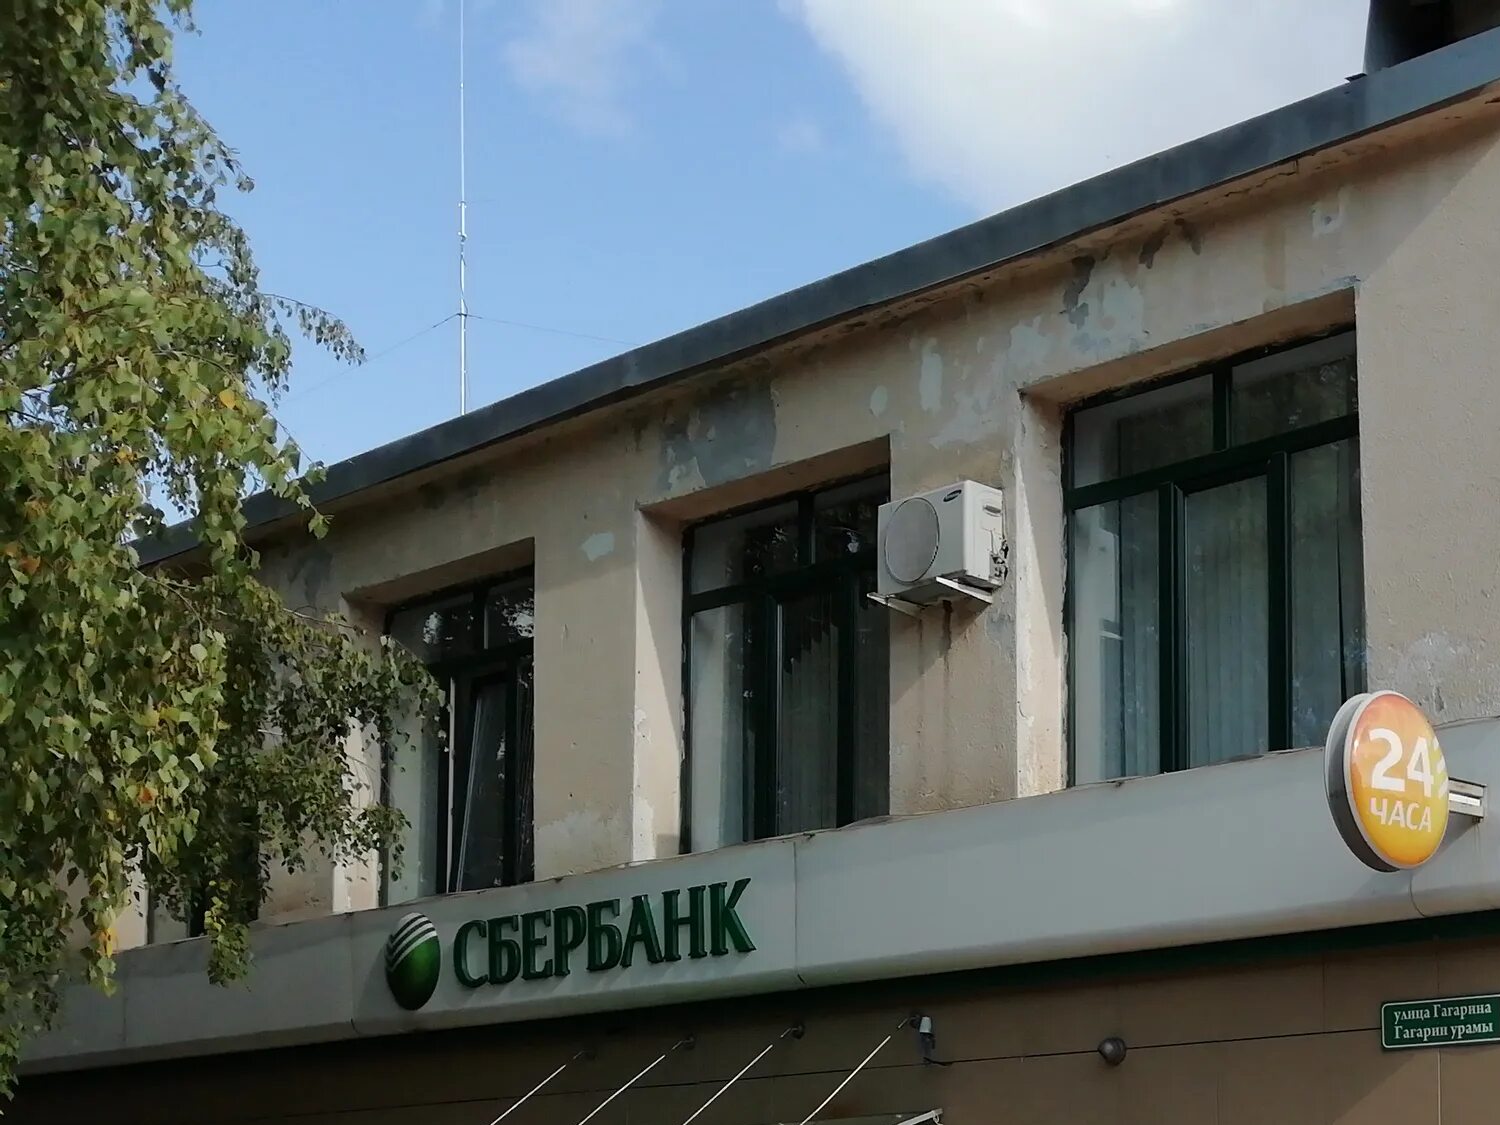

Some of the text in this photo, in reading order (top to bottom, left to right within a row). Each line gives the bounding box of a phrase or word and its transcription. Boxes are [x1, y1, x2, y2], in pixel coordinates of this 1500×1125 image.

[1369, 728, 1434, 798] 24
[1370, 797, 1431, 833] ЧАСА
[453, 878, 757, 988] СБЕРБАНК
[1393, 1003, 1492, 1025] улица Гагарина
[1394, 1022, 1493, 1042] Гагарин урамы
